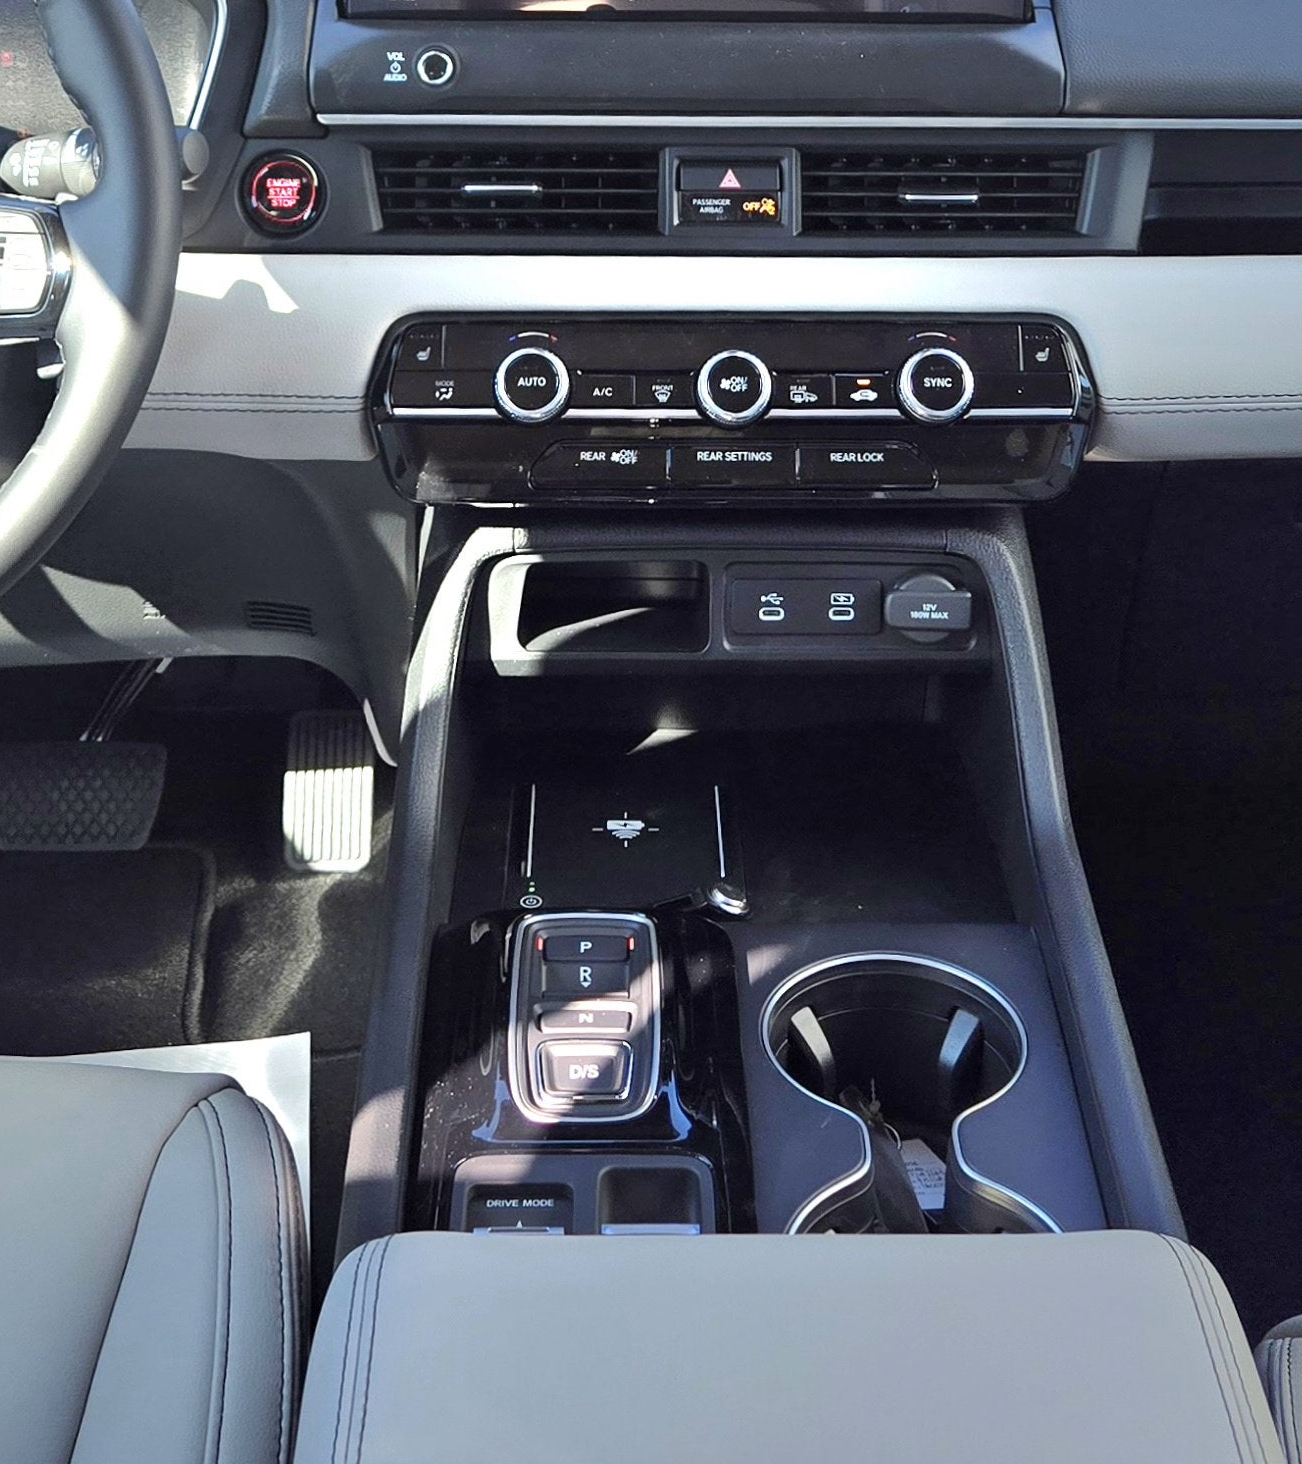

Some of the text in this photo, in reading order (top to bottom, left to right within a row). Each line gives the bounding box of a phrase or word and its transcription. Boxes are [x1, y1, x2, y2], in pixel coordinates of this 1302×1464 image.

[386, 51, 405, 61] VOL
[383, 73, 407, 82] AUDIO
[266, 178, 300, 188] ENGINE
[269, 187, 298, 197] START
[270, 198, 296, 207] STOP
[692, 198, 731, 206] PASSENGER
[742, 202, 760, 211] OFF
[699, 206, 724, 214] AIRBAG
[517, 376, 547, 387] AUTO
[730, 376, 748, 384] ON/
[923, 377, 952, 388] SYNC
[592, 387, 613, 397] A/C
[651, 384, 674, 392] FRONT
[730, 384, 748, 392] OFF
[580, 451, 606, 461] REAR
[619, 457, 638, 465] OFF
[697, 451, 772, 462] REAR SETTINGS
[830, 452, 884, 463] REAR LOCK
[922, 603, 937, 611] 12V
[931, 611, 949, 619] MAX
[580, 941, 593, 954] P
[579, 966, 592, 982] R
[578, 1013, 594, 1023] N
[569, 1064, 600, 1080] D/S
[486, 1198, 554, 1208] DRIVE MODE
